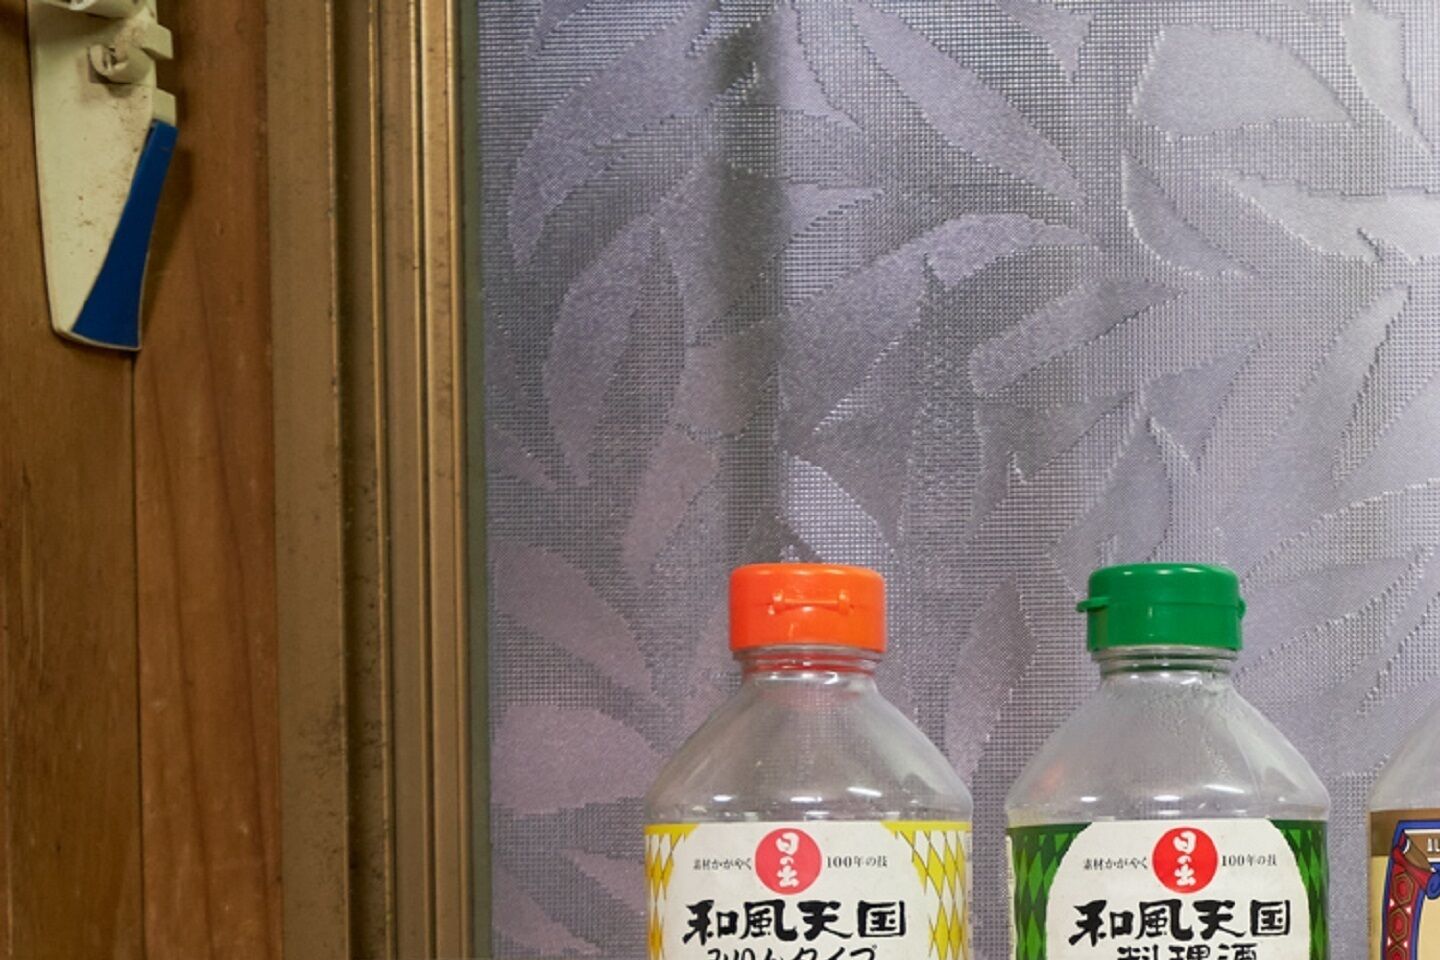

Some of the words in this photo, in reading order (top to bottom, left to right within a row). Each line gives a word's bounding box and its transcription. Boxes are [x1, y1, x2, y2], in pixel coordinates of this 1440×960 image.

[775, 831, 800, 888] 日の出
[826, 855, 888, 869] 100年の技
[1083, 857, 1149, 871] 素材かがやく
[1171, 830, 1198, 887] 日の出
[1221, 855, 1277, 868] 100年の技
[682, 899, 905, 946] 和風天国
[1068, 898, 1292, 947] 和風天国
